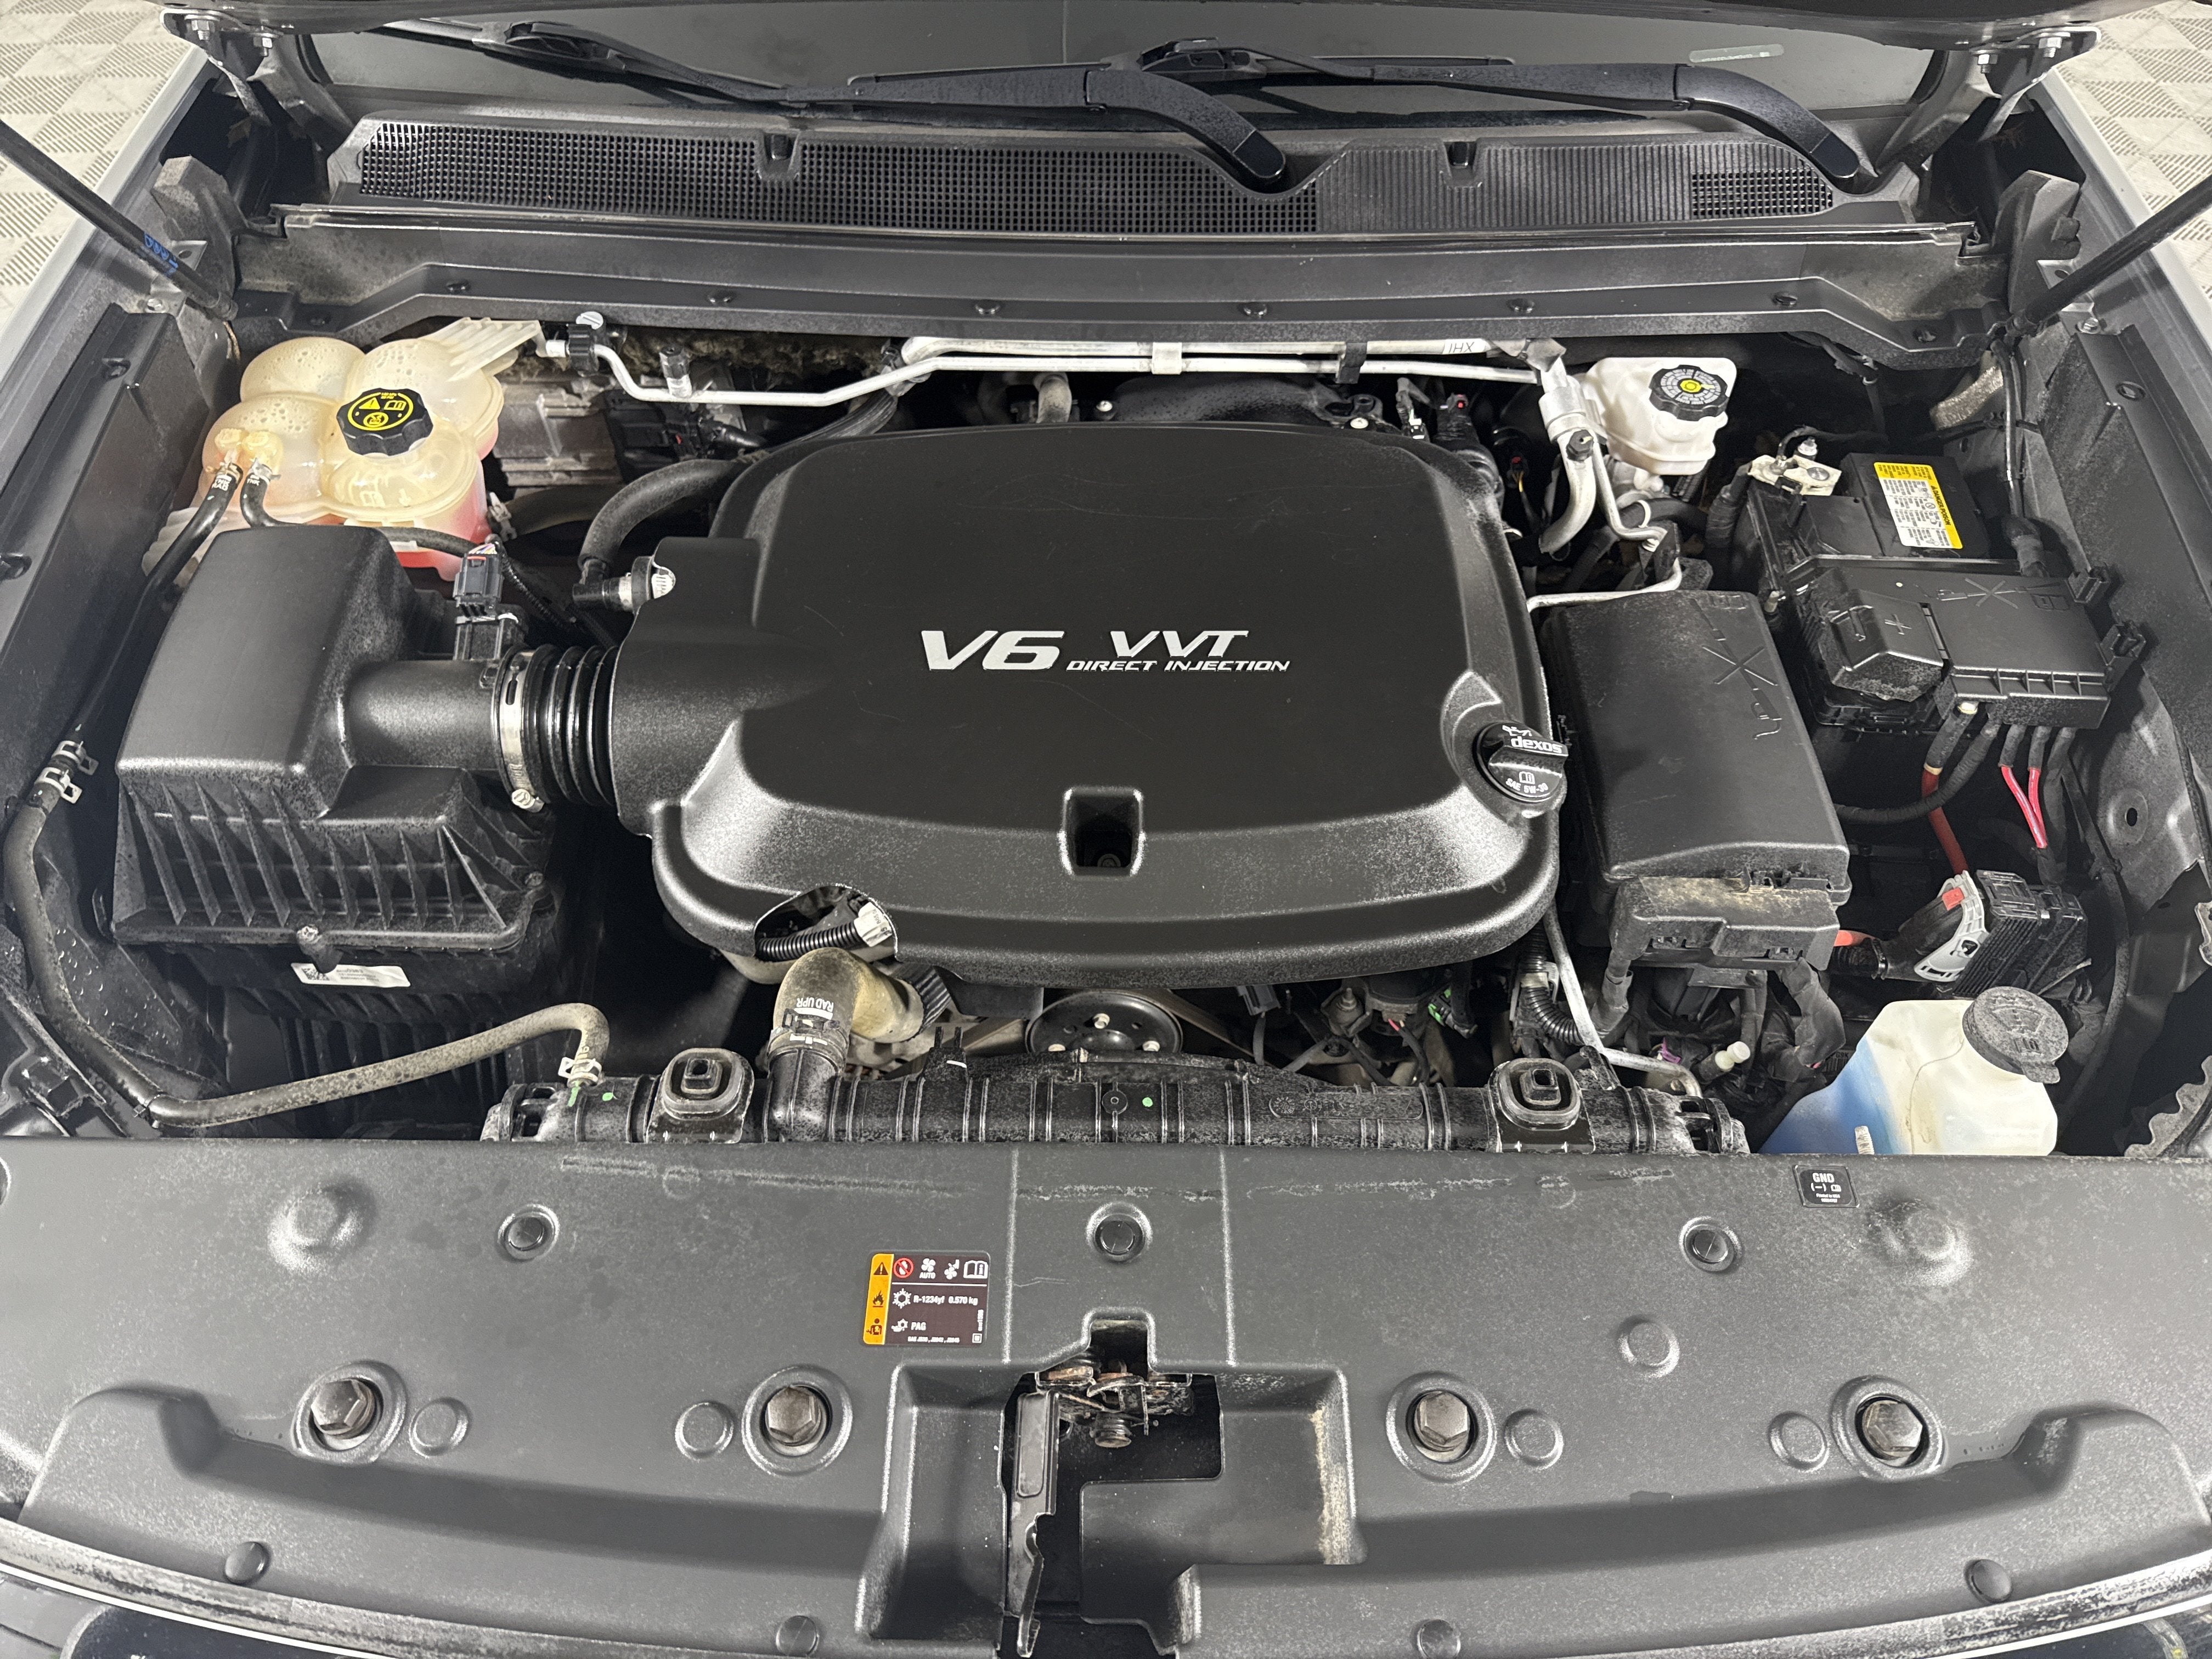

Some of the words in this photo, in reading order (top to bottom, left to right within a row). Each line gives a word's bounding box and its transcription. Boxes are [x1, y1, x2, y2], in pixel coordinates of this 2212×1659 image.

[921, 630, 1065, 670] V6
[1110, 630, 1249, 658] VVT
[1066, 660, 1158, 672] DIRECT
[1164, 661, 1290, 672] INJECTION
[1510, 736, 1563, 754] dexos
[1505, 778, 1521, 791] SAE
[1523, 782, 1549, 794] 5W-30
[795, 997, 814, 1008] UPR
[815, 998, 834, 1013] RAD
[1812, 1172, 1835, 1183] GND
[913, 1295, 945, 1305] R-1234yf
[948, 1296, 968, 1304] 0.570
[968, 1296, 978, 1306] kg
[911, 1322, 926, 1331] PAG
